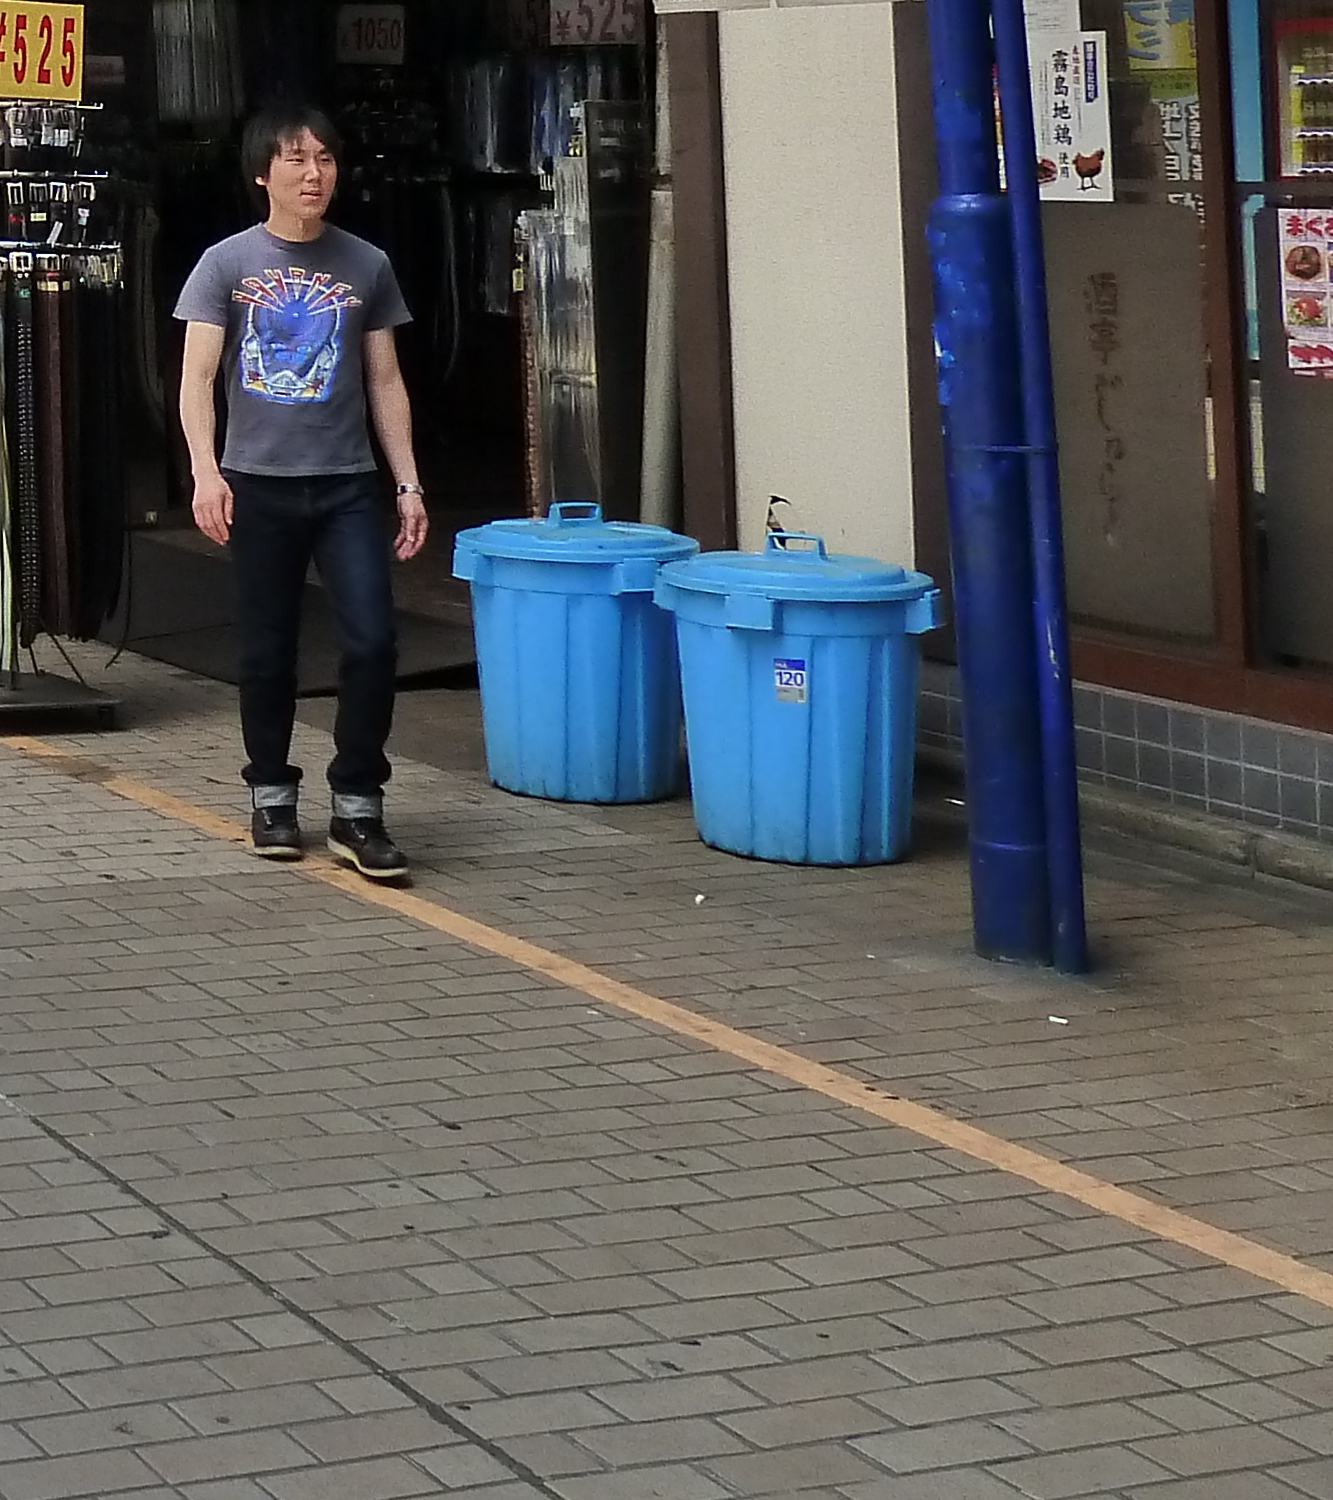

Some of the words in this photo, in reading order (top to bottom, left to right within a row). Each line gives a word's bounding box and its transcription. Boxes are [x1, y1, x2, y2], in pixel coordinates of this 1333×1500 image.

[1052, 49, 1073, 146] 霧島地鶏
[776, 671, 804, 687] 120
